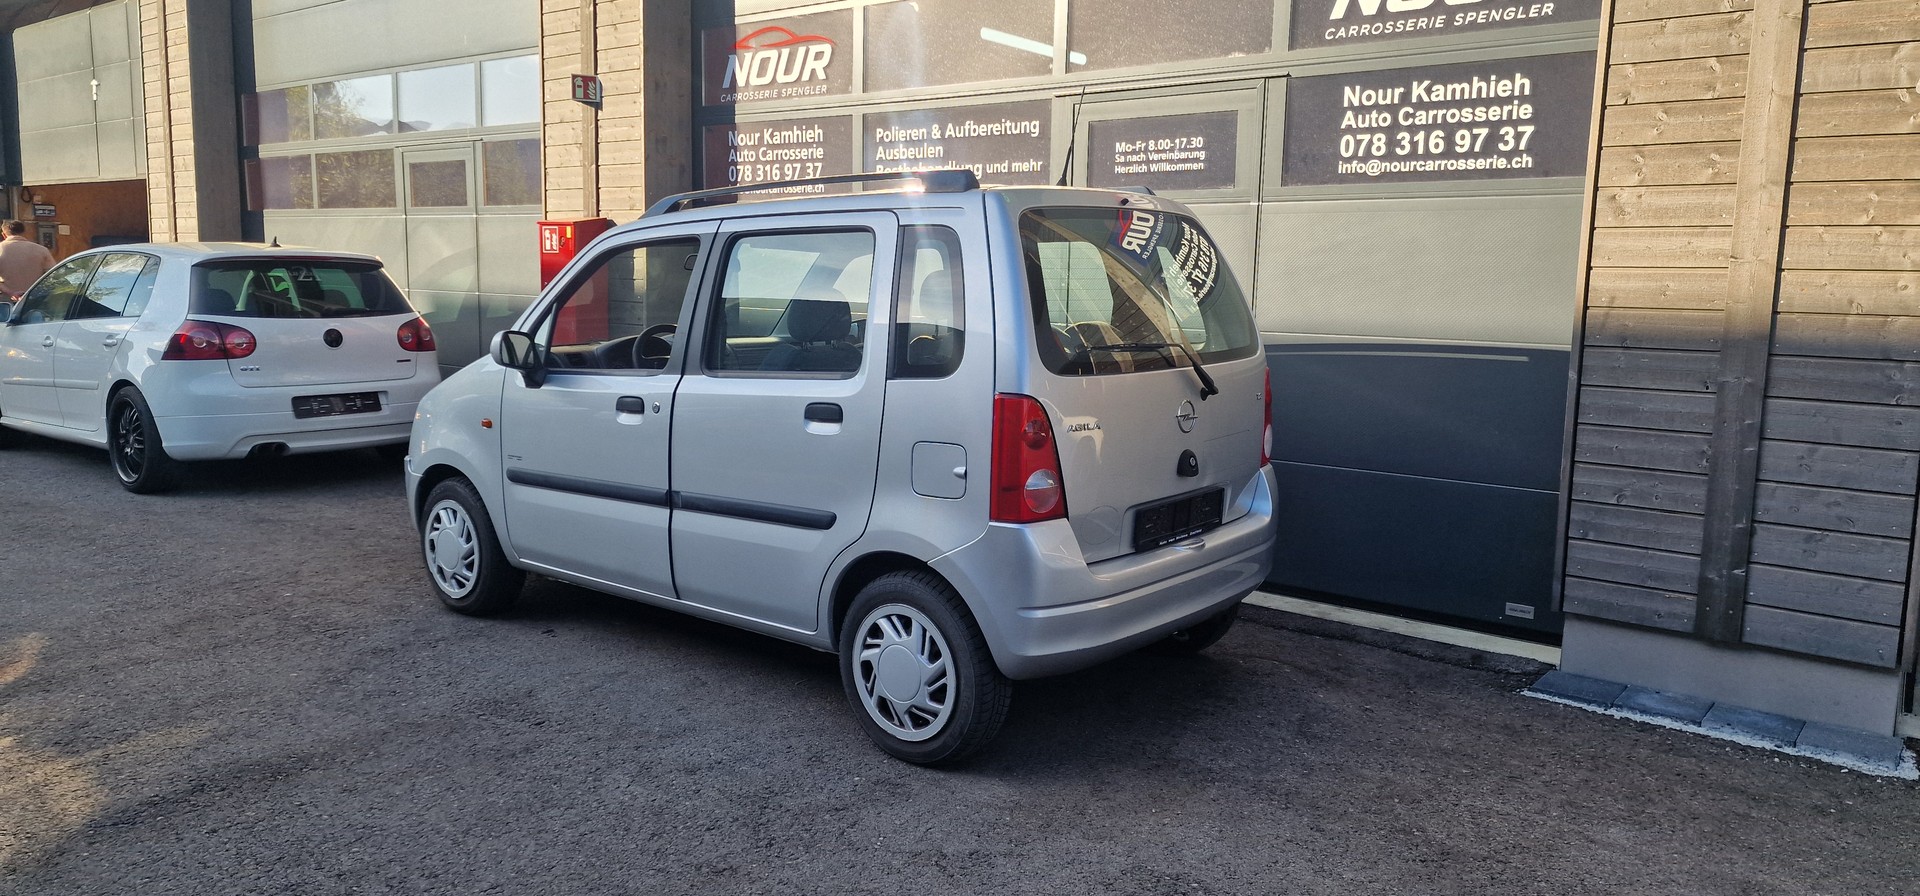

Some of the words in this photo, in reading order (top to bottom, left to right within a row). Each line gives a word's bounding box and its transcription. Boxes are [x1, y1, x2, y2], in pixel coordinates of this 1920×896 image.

[1325, 15, 1447, 40] CARROSSERIE
[1453, 2, 1555, 27] SPENGLER
[722, 43, 833, 89] NOUR
[720, 89, 778, 103] CARROSSERIE
[781, 85, 828, 98] SPENGLER
[1343, 86, 1404, 108] Nour
[1411, 73, 1531, 103] Kamhieh
[1340, 111, 1392, 129] Auto
[1398, 100, 1533, 127] Carrosserie
[728, 131, 760, 147] Nour
[763, 124, 824, 145] Kamhieh
[876, 126, 927, 143] Polieren
[931, 124, 942, 139] &
[945, 119, 1040, 138] Aufbereitung
[1115, 141, 1146, 153] Mo-Fr
[1148, 136, 1204, 151] 8.00-17.30
[1339, 133, 1387, 158] 078
[1395, 130, 1445, 156] 316
[1454, 128, 1489, 153] 97
[1497, 125, 1535, 152] 37
[728, 149, 756, 162] Auto
[758, 144, 824, 161] Carrosserie
[876, 143, 944, 161] Ausbeulen
[1114, 154, 1125, 163] Sa
[1126, 152, 1146, 162] nach
[1148, 149, 1206, 161] Vereinbarung
[728, 165, 752, 182] 078
[755, 164, 780, 181] 316
[784, 163, 801, 180] 97
[805, 162, 823, 179] 37
[986, 160, 1008, 174] und
[1011, 159, 1043, 173] mehr
[1114, 164, 1147, 174] Herzlich
[1149, 161, 1204, 173] Willkommen
[1337, 153, 1533, 177] info@nourcarrosserie.ch
[1066, 422, 1101, 433] AGILA
